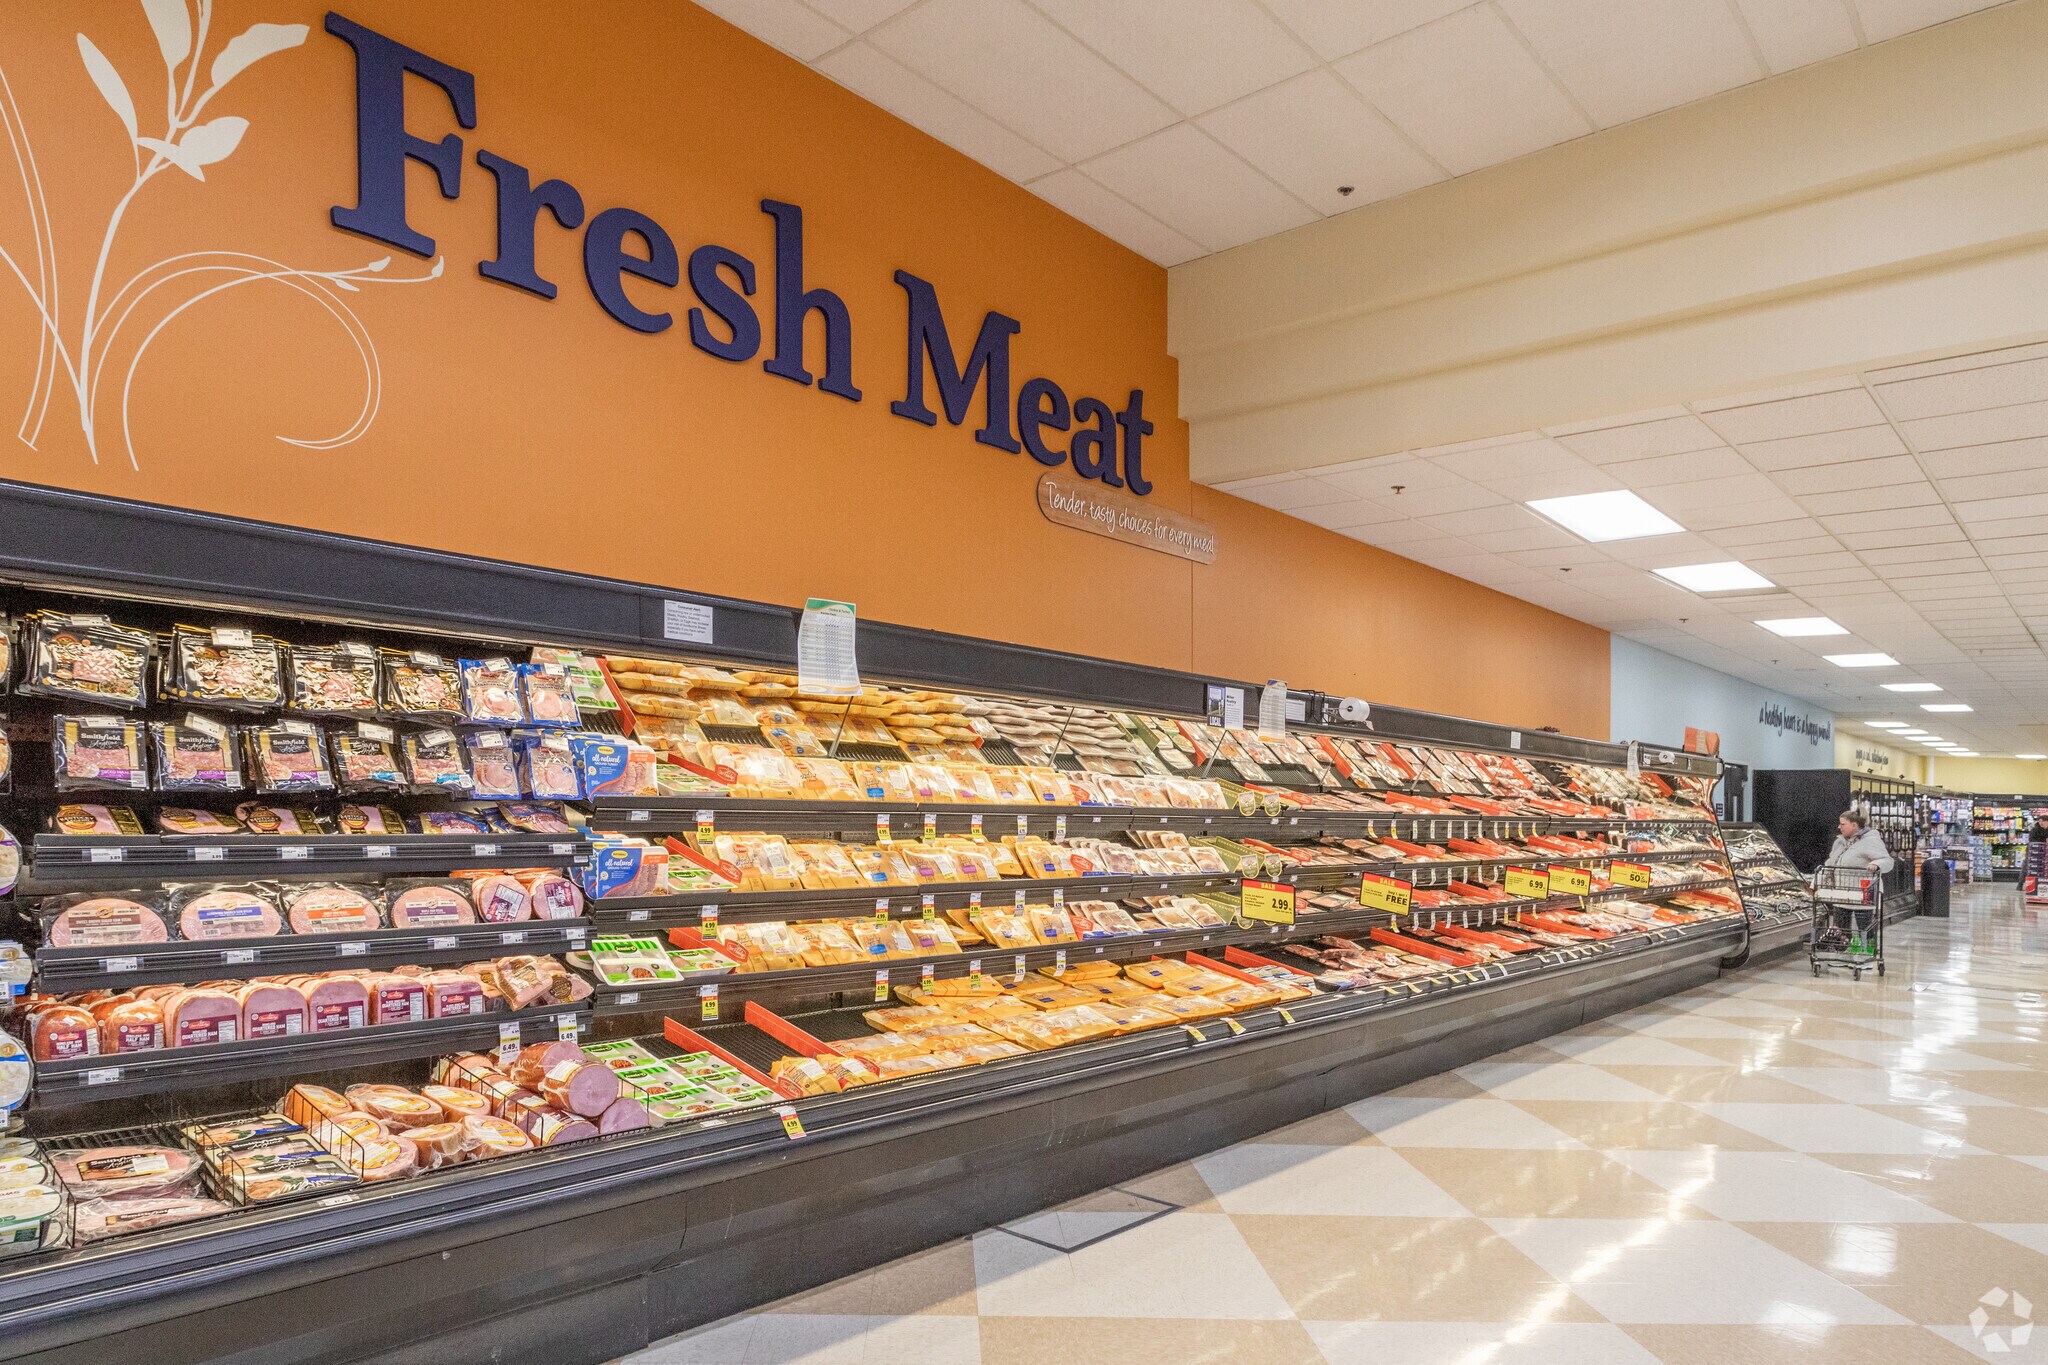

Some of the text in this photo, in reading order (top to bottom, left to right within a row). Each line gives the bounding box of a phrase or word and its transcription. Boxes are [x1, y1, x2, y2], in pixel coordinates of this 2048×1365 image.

[324, 10, 1154, 496] Fresh Meat
[1046, 481, 1215, 555] Tender, tasty choices for every meal
[1210, 716, 1222, 726] LOCAL
[1764, 701, 1782, 737] healthy
[1784, 706, 1796, 732] heart
[1797, 716, 1801, 732] is
[1806, 714, 1818, 746] happy
[80, 733, 122, 741] Smithfield
[1379, 878, 1395, 887] SALE
[1570, 878, 1585, 887] 6.99
[1630, 874, 1640, 882] 50
[1529, 880, 1543, 889] 6.99
[1272, 898, 1288, 910] 2.99
[1386, 894, 1408, 905] FREE
[90, 1155, 141, 1166] Smithfield
